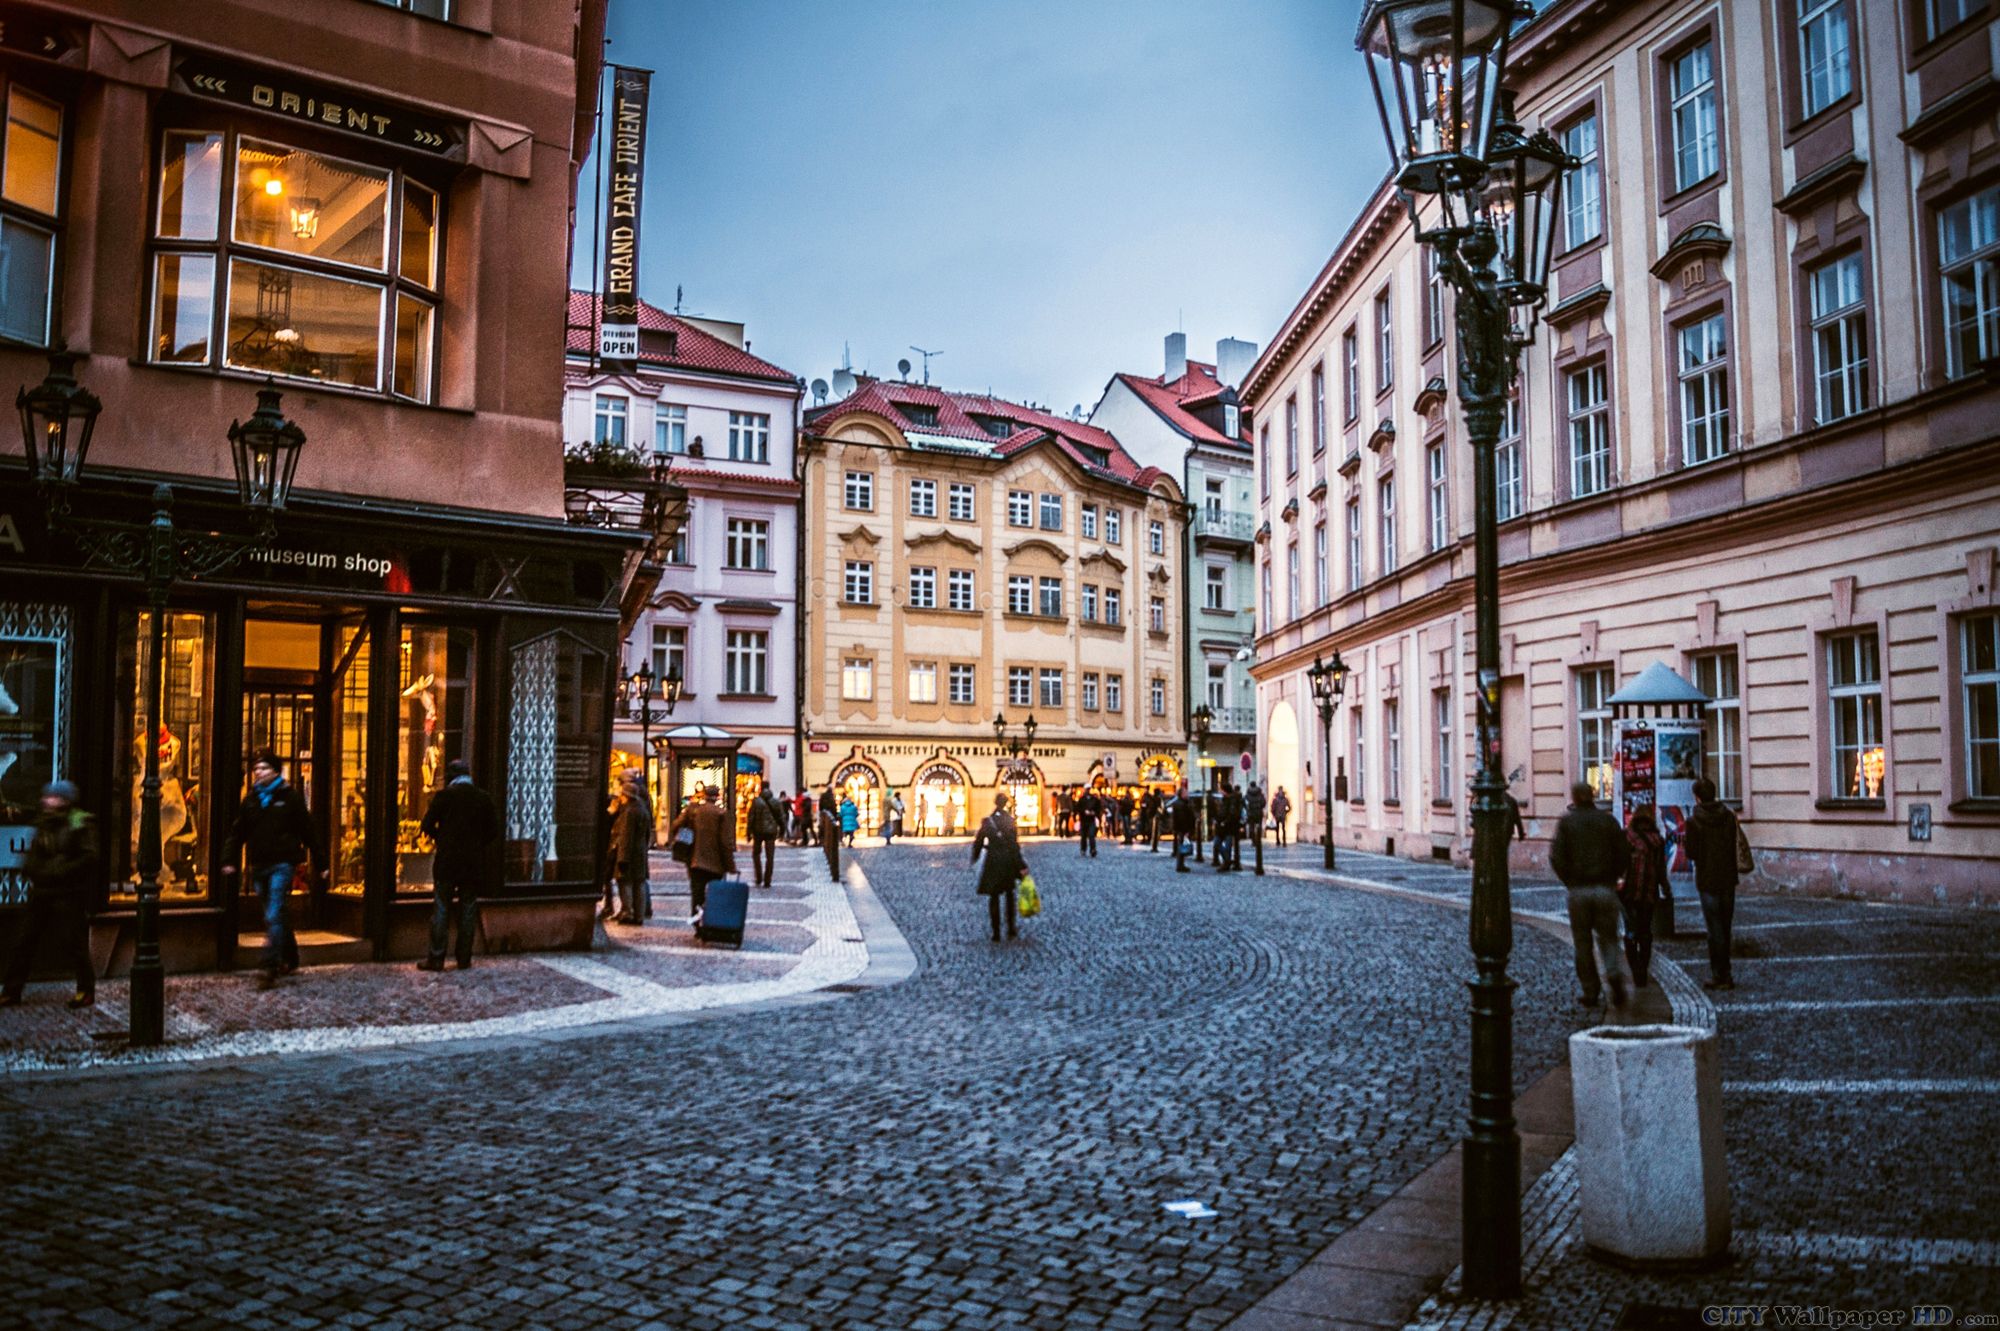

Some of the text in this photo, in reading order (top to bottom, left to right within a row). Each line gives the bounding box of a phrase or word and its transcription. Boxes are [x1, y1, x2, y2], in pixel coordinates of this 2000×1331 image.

[252, 84, 392, 136] ORIENT
[609, 97, 643, 294] GRAND CAFE ORIENT
[603, 341, 635, 354] OPEN
[250, 548, 392, 578] museum shop
[866, 744, 934, 756] ZLATNICTVÍ
